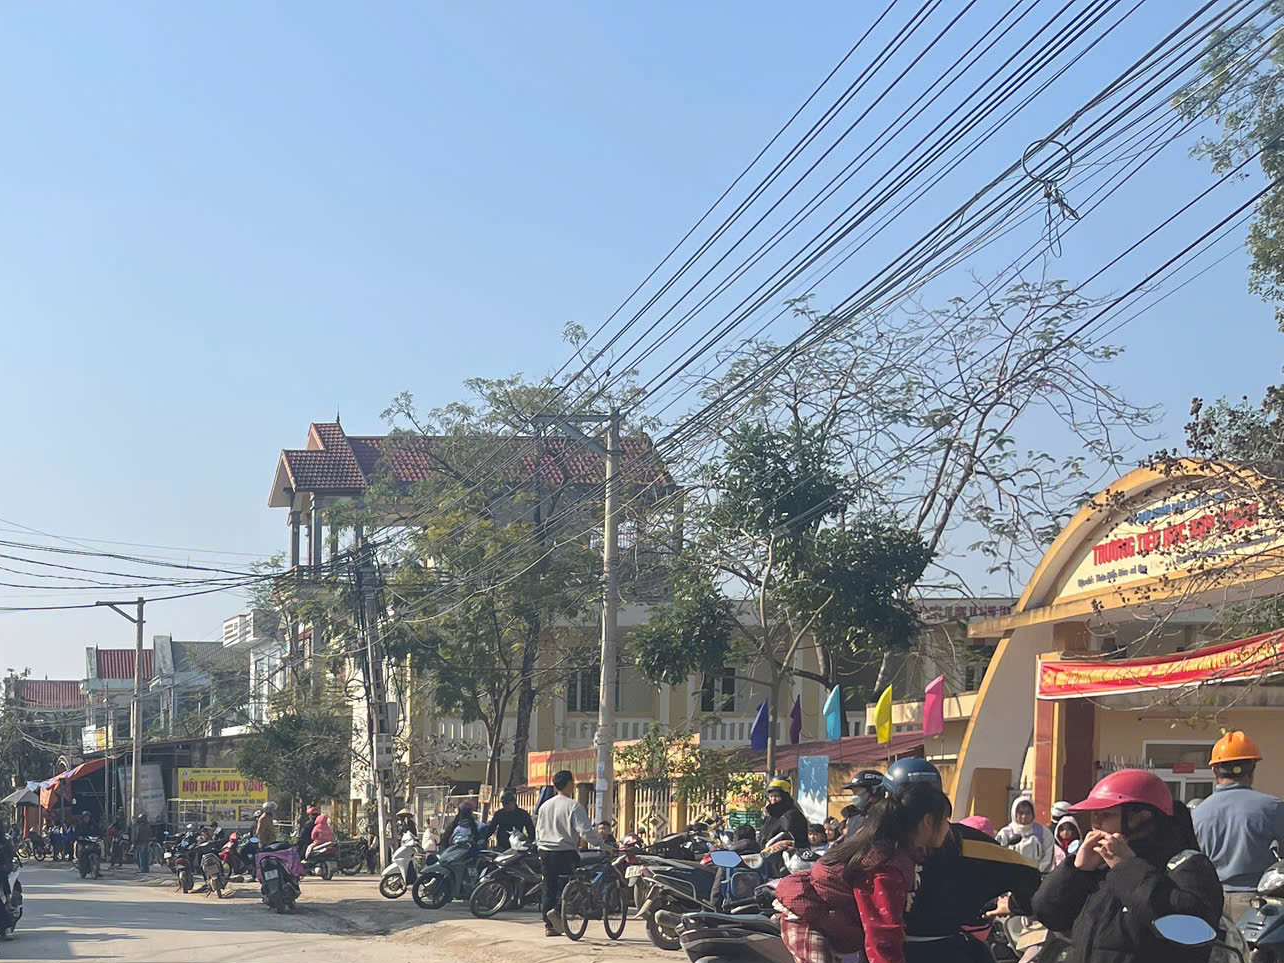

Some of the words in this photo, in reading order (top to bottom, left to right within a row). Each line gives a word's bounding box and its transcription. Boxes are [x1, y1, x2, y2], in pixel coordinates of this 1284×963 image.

[182, 777, 197, 795] NỘI
[201, 776, 221, 792] THẤT
[224, 780, 240, 792] DUY
